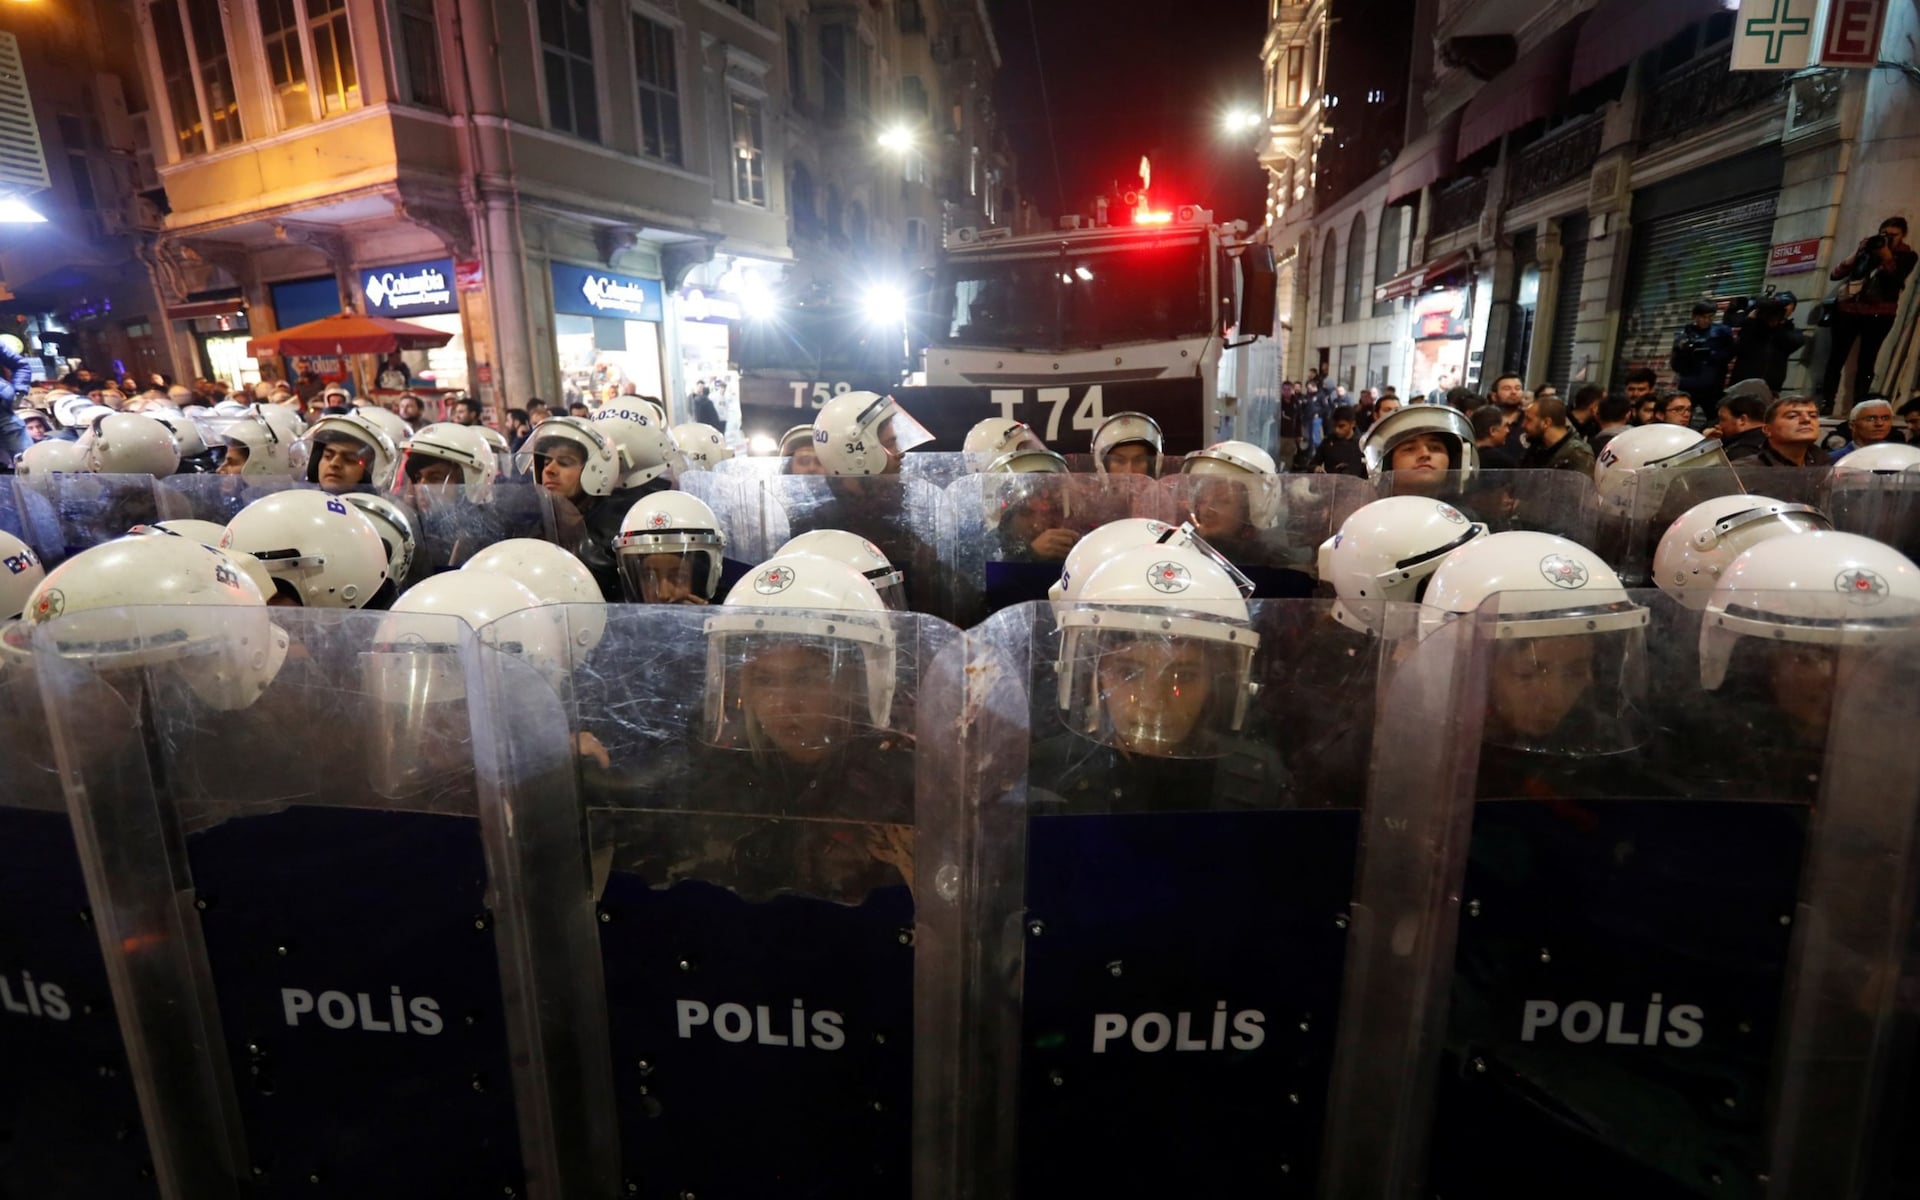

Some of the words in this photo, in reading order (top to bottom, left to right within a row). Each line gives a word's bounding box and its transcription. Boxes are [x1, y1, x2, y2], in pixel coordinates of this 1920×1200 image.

[1837, 1, 1873, 53] E
[845, 441, 865, 454] 34
[281, 986, 443, 1036] POLİS
[676, 998, 846, 1051] POLİS
[1092, 1000, 1266, 1054] POLİS
[1520, 992, 1704, 1048] POLİS
